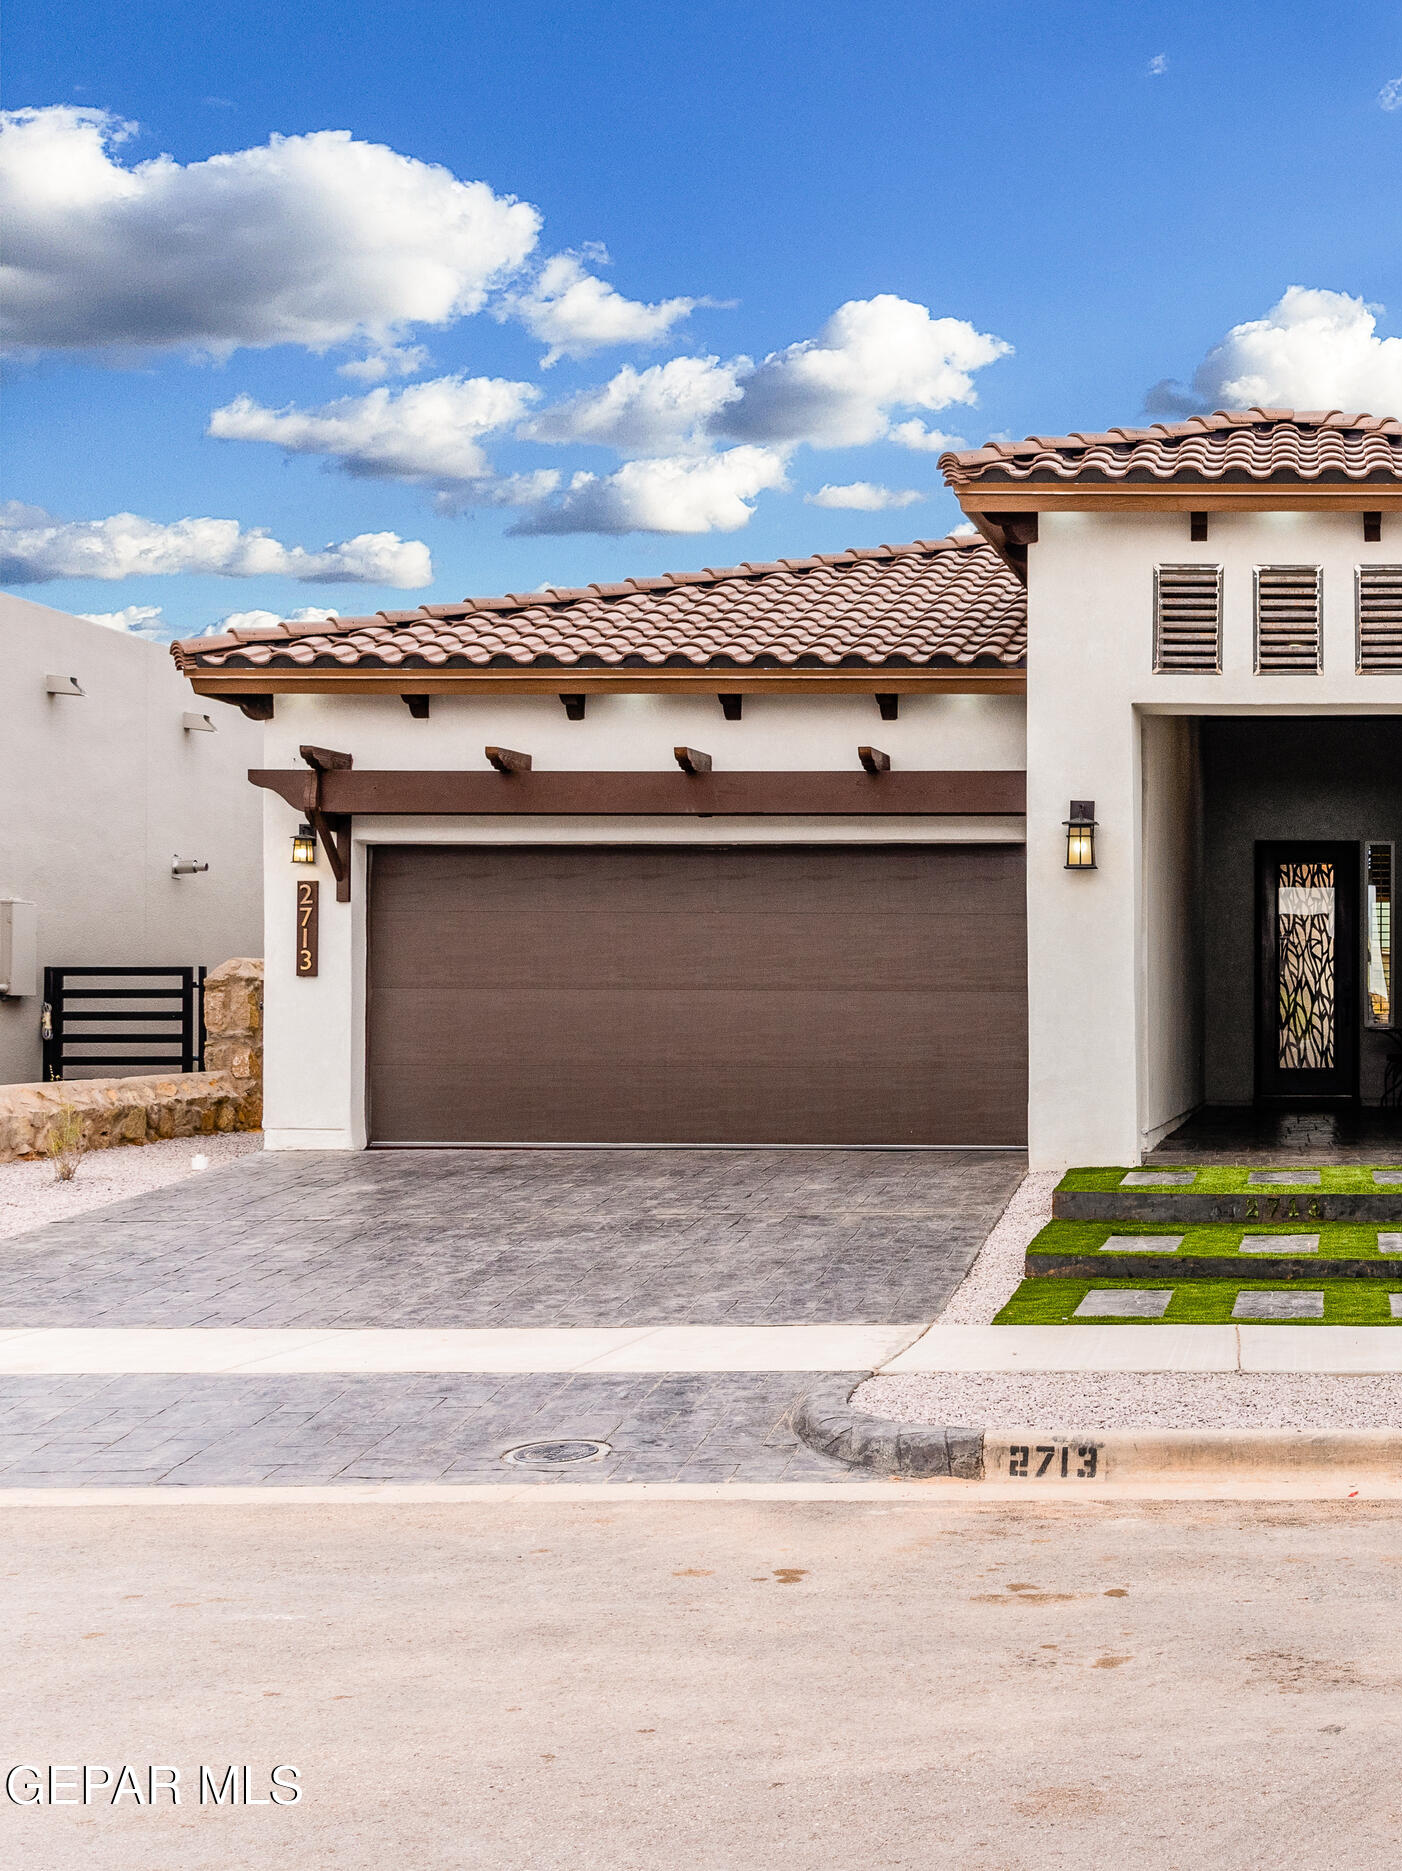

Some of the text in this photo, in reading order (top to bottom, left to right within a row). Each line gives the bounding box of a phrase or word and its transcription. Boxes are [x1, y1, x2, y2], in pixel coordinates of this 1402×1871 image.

[299, 884, 313, 971] 2713
[1245, 1197, 1321, 1218] 2713
[1009, 1446, 1098, 1478] 2713
